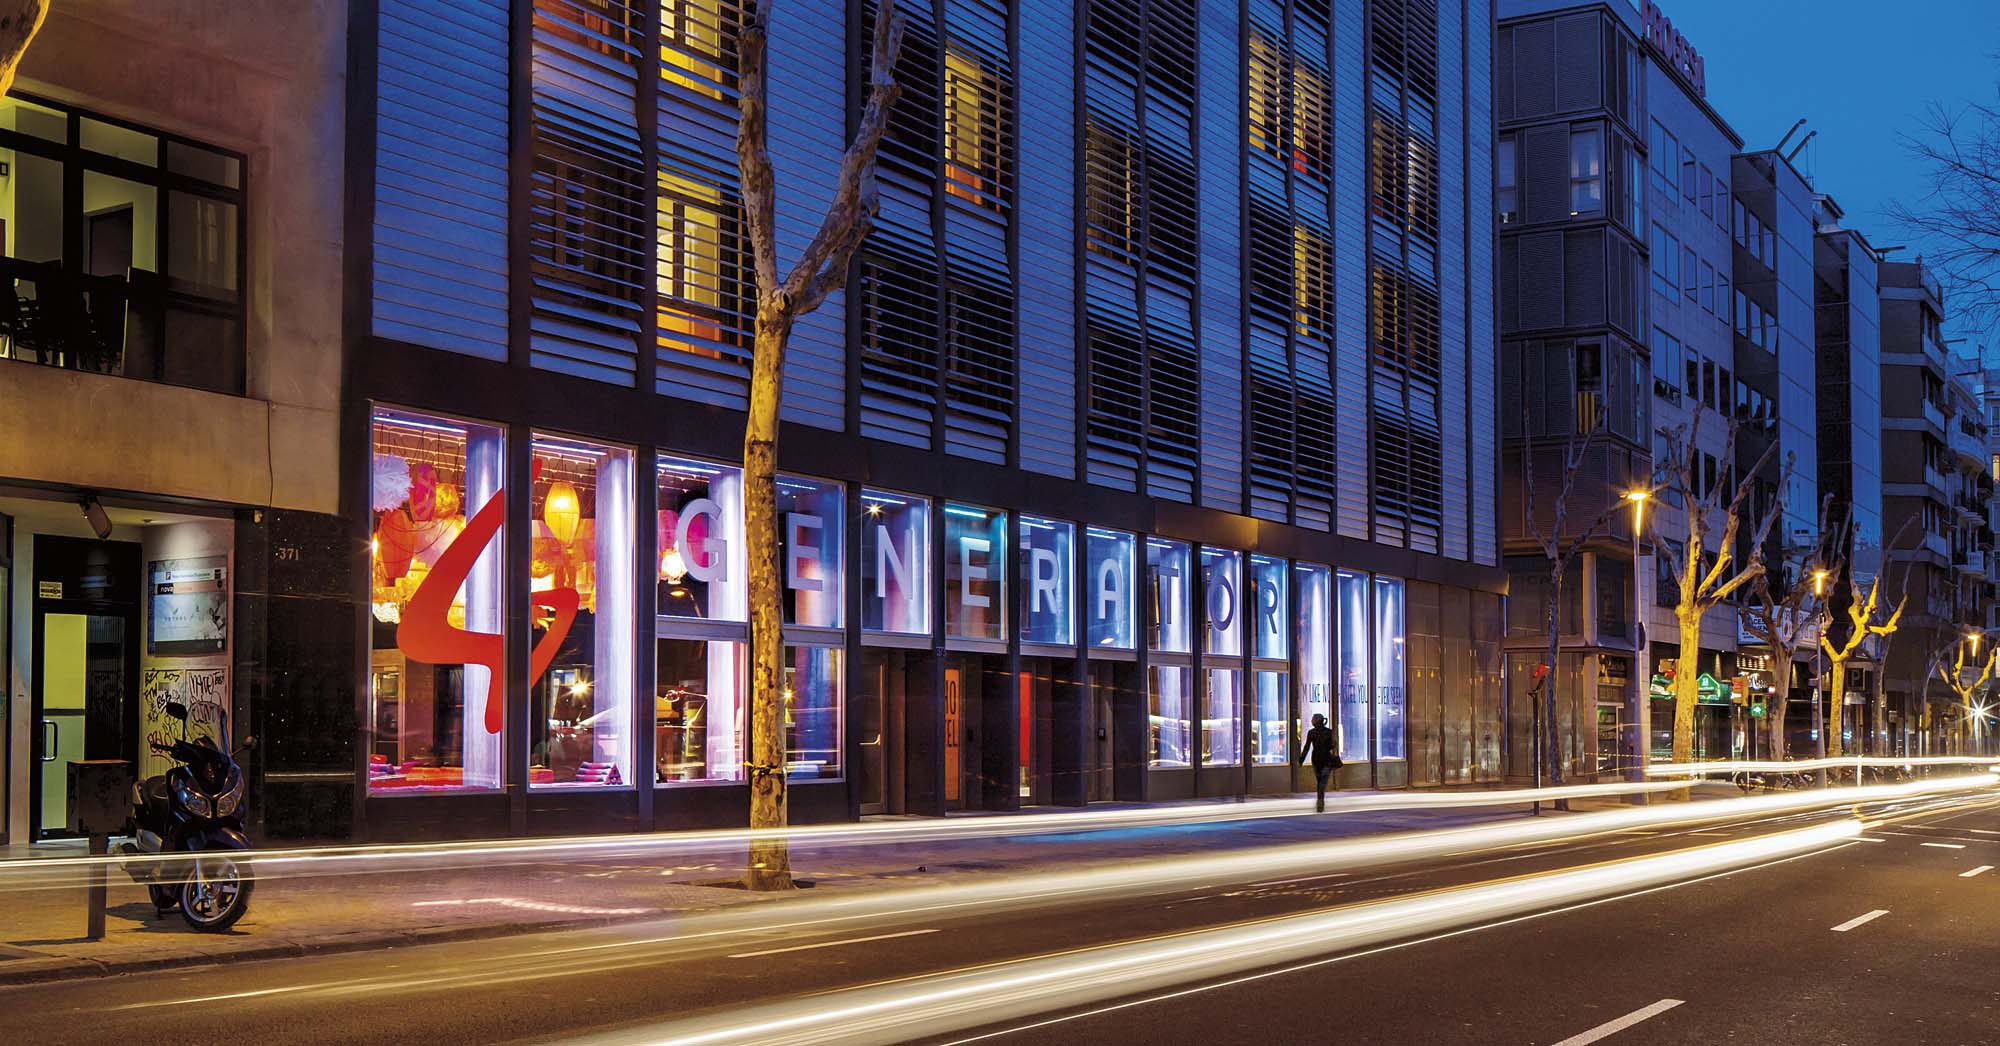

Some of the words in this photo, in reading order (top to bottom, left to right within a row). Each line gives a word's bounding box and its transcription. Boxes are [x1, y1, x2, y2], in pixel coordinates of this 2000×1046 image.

[279, 547, 299, 561] 371
[675, 498, 1279, 634] GENERATOR
[1309, 683, 1321, 703] LIKE
[1378, 686, 1390, 705] EVER
